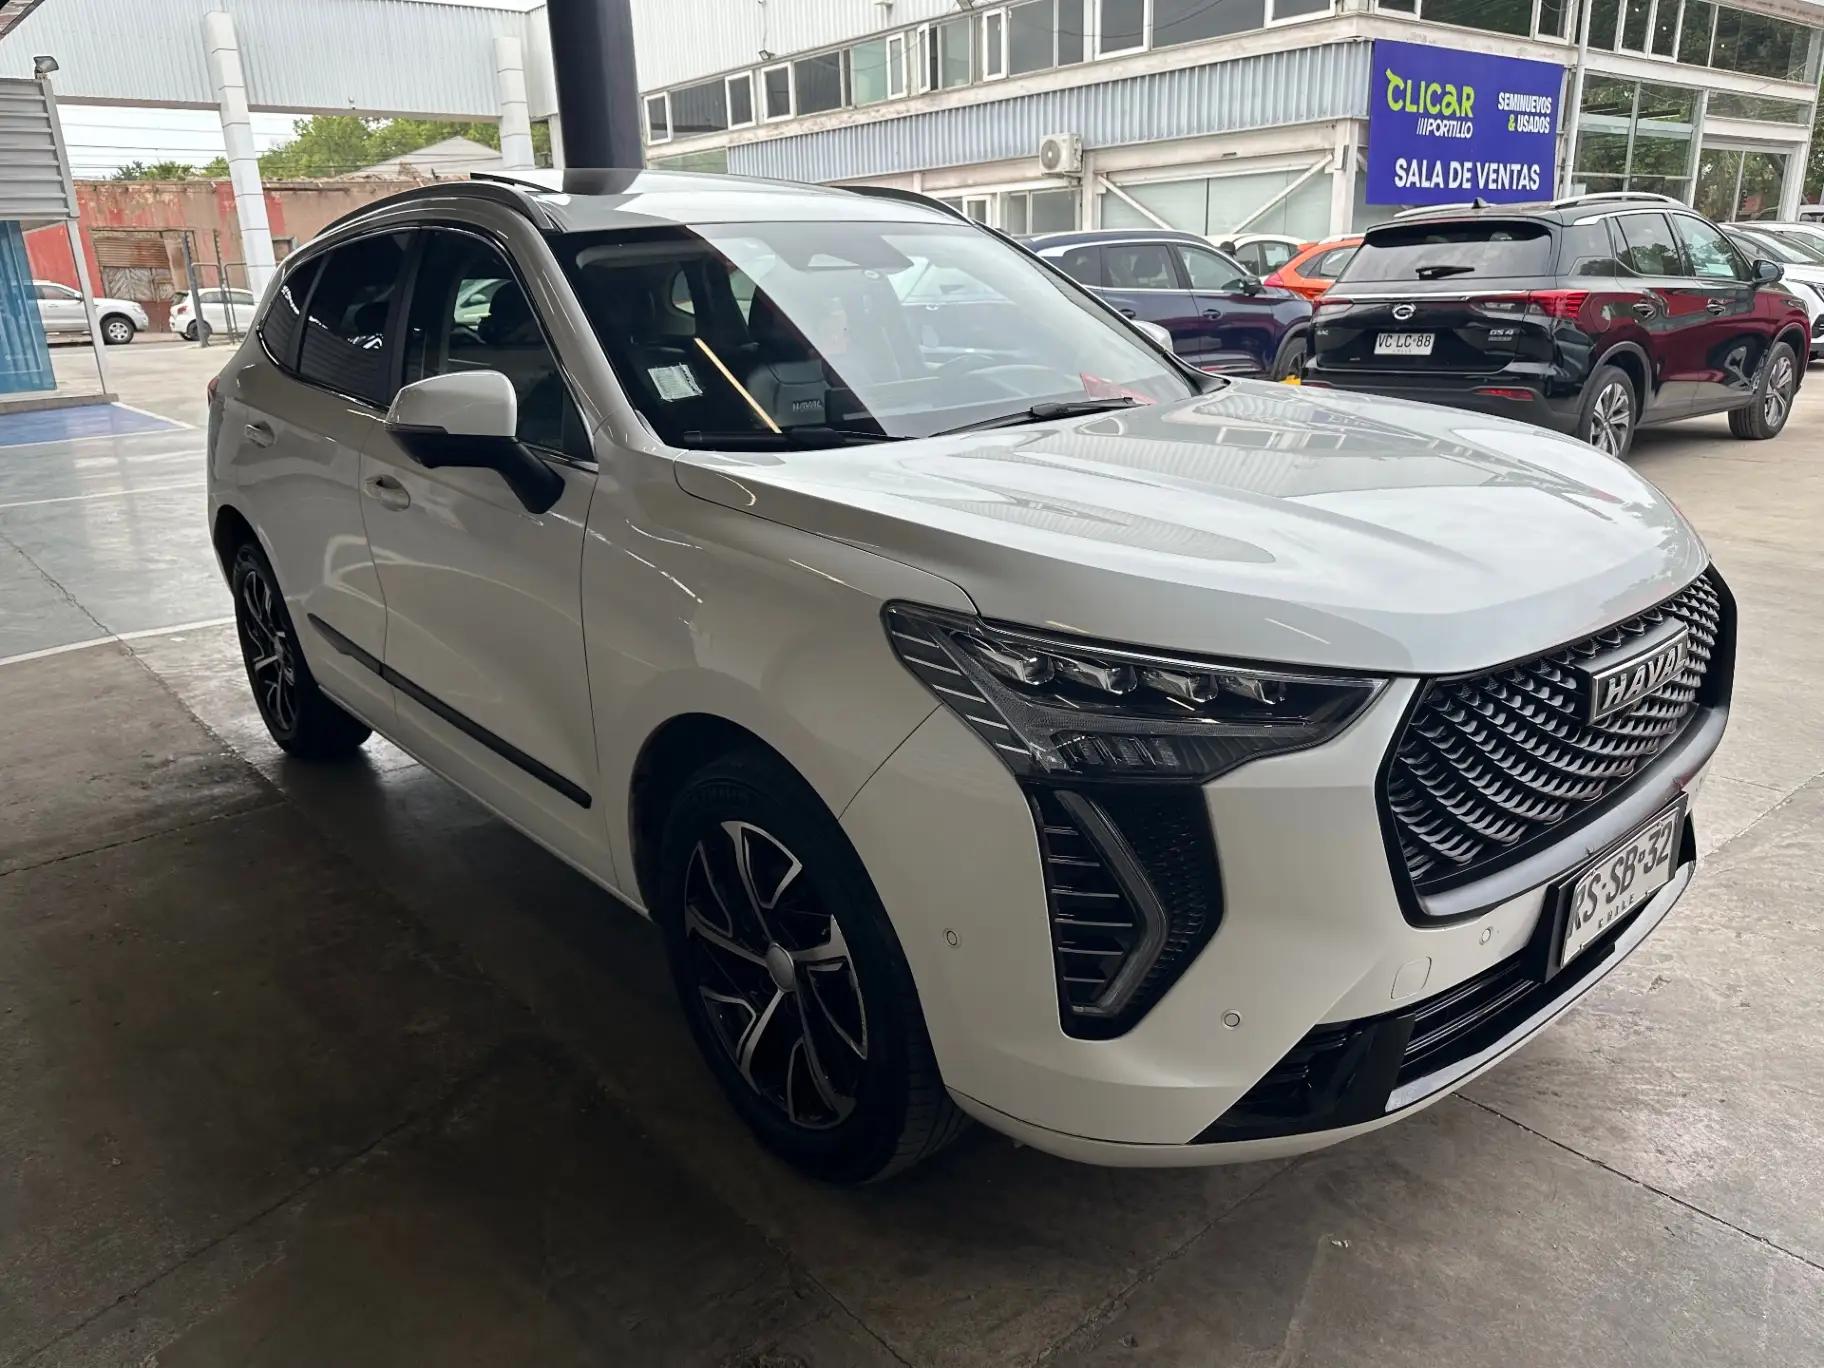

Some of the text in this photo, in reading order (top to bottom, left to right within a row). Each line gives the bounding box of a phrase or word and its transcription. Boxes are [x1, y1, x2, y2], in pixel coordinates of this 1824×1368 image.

[1498, 92, 1552, 114] SEMINUEVOS
[1508, 115, 1550, 134] & USADOS
[1394, 158, 1540, 190] SALA DE VENTAS
[1602, 643, 1686, 709] HAVAL
